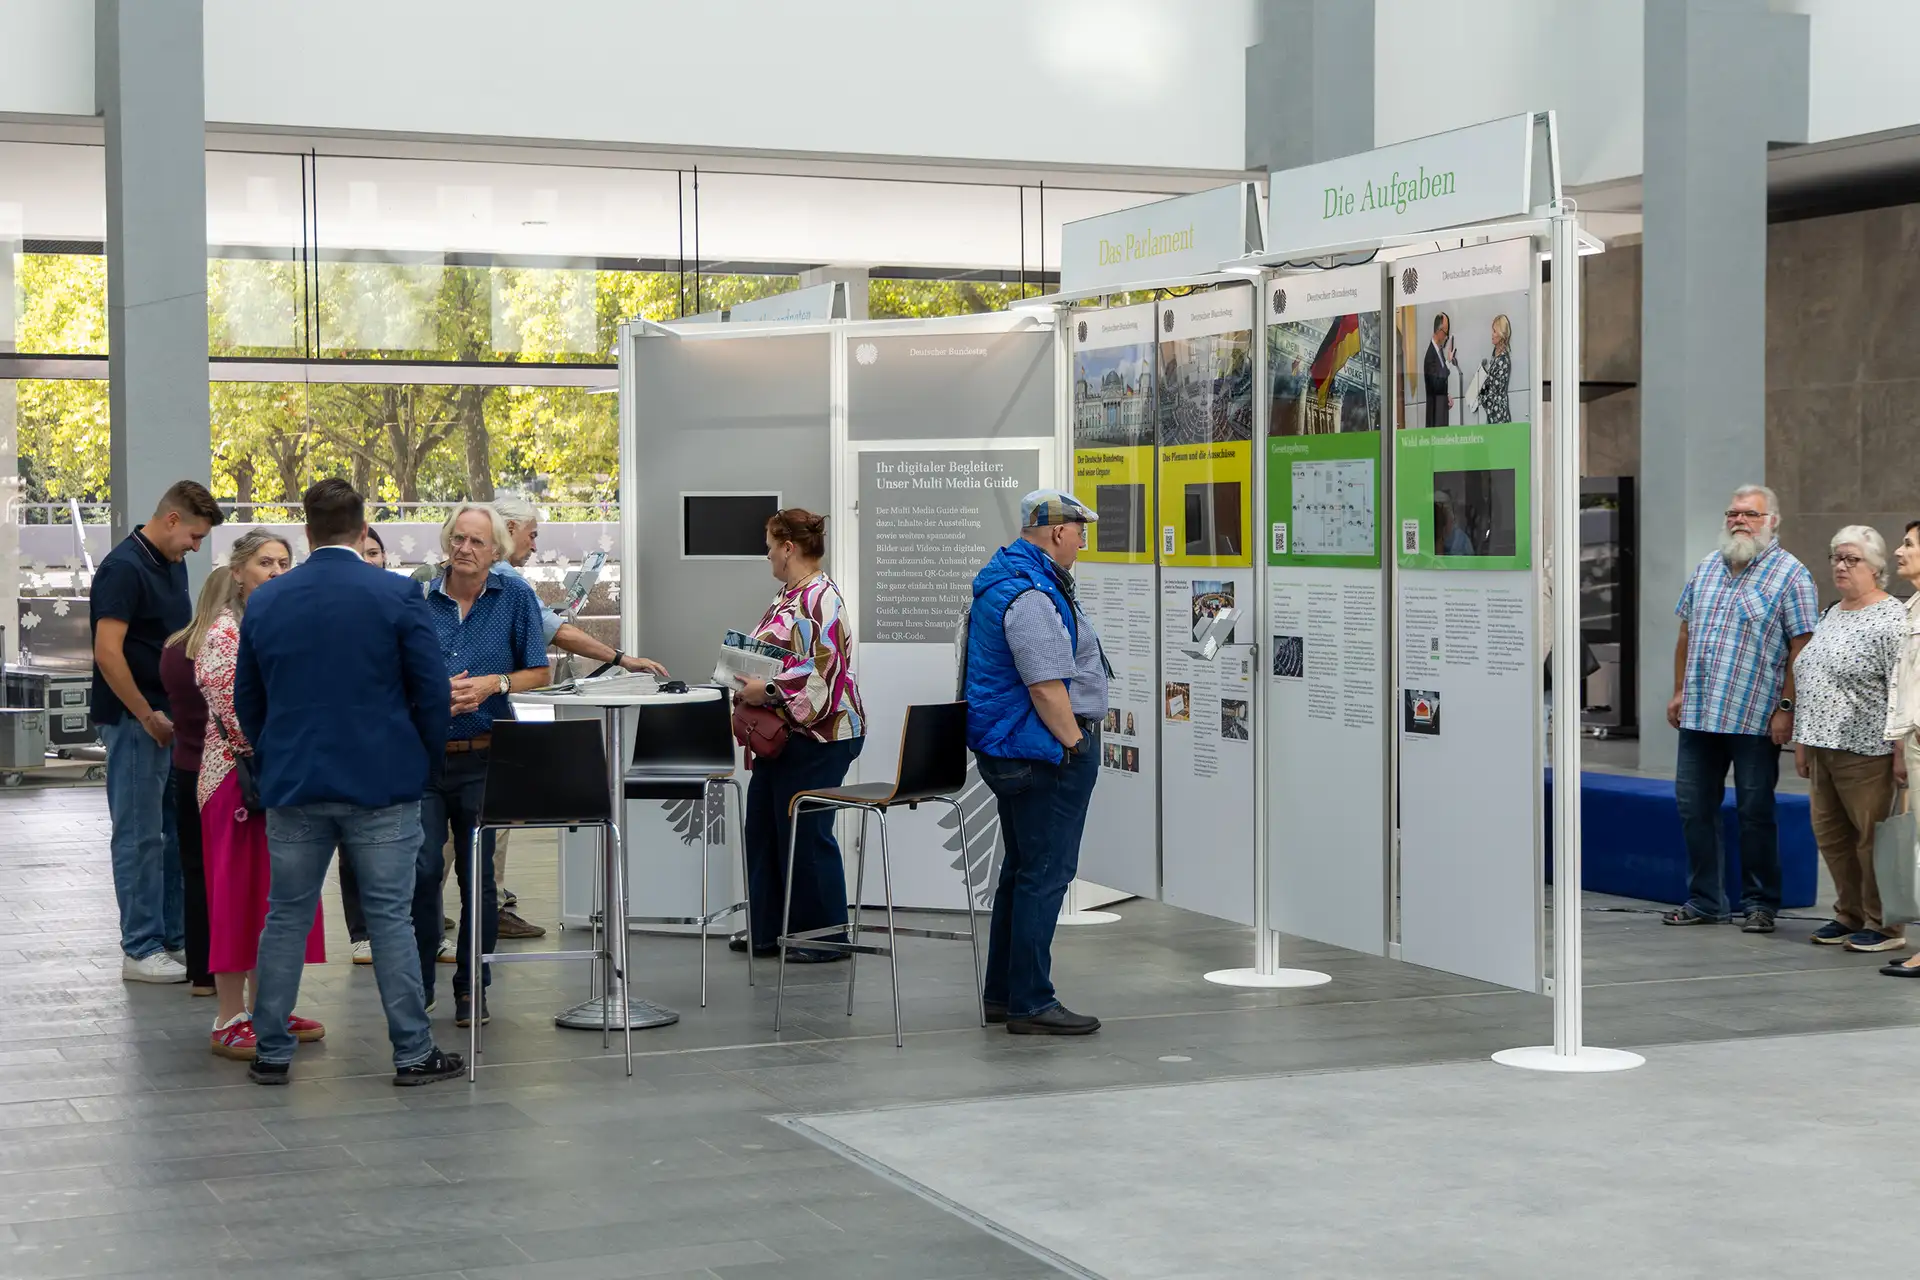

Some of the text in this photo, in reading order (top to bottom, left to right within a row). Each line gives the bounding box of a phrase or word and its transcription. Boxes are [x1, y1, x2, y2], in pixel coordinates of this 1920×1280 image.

[1323, 166, 1457, 220] Die Aufgaben
[1098, 223, 1195, 267] Das Parlament
[909, 346, 988, 357] Deutscher Bundestag
[876, 461, 1004, 476] Ihr digitaler Begleiter:
[876, 476, 1019, 489] Unser Multi Media Guide
[897, 519, 922, 527] Inhalte
[924, 519, 937, 527] der
[938, 519, 981, 528] Ausstellung
[876, 532, 966, 541] sowie weitere spannende
[876, 544, 899, 552] Bilder
[916, 544, 940, 552] Videos
[942, 544, 952, 552] im
[953, 544, 986, 554] digitalen
[876, 557, 982, 565] Raum abzurufen. Anhand der
[876, 569, 923, 577] vorhandenen
[924, 569, 960, 579] QR-Codes
[876, 582, 971, 591] Sie ganz einfach mit Ihrem
[876, 595, 920, 604] Smartphone
[876, 607, 900, 615] Guide.
[902, 607, 929, 615] Richten
[931, 607, 943, 615] Sie
[876, 620, 957, 629] Kamera Ihres Smartph
[891, 632, 926, 641] QR-Code.
